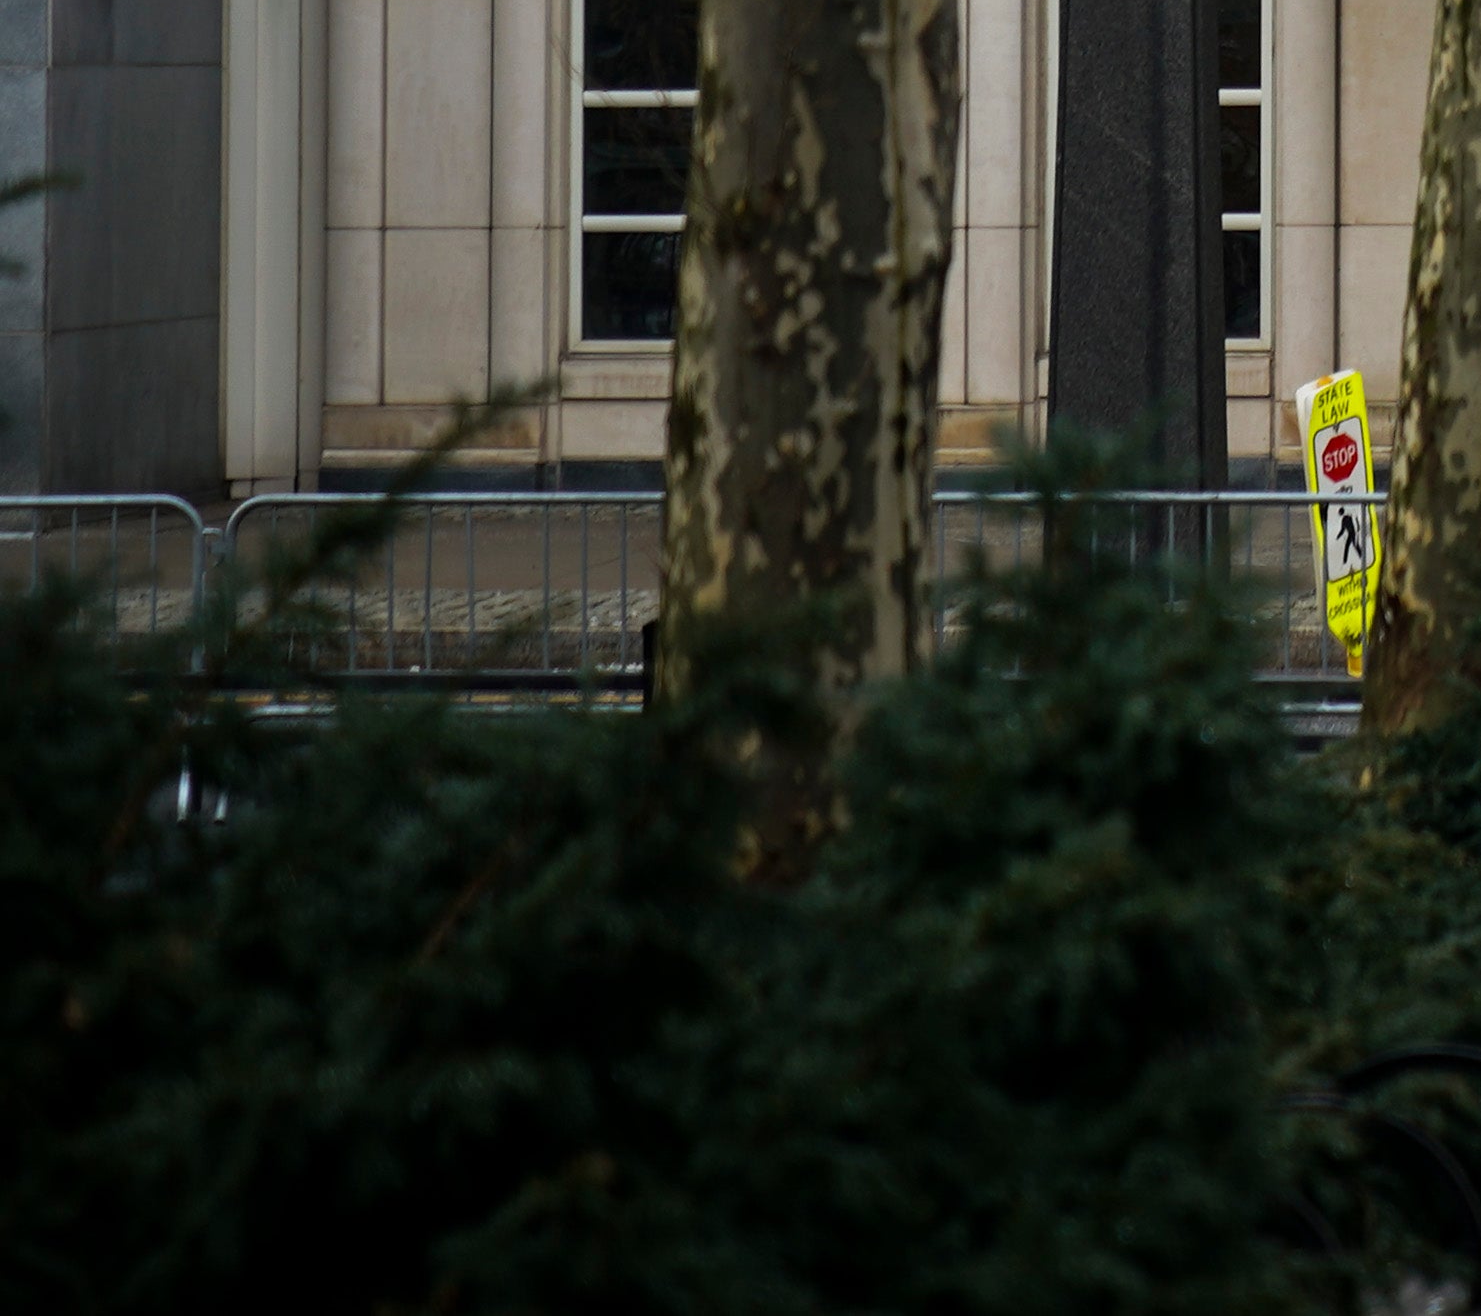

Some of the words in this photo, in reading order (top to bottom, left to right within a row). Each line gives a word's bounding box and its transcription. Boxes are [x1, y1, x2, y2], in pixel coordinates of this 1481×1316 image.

[1318, 380, 1353, 409] STATE
[1321, 400, 1349, 424] LAW
[1324, 443, 1356, 473] STOP
